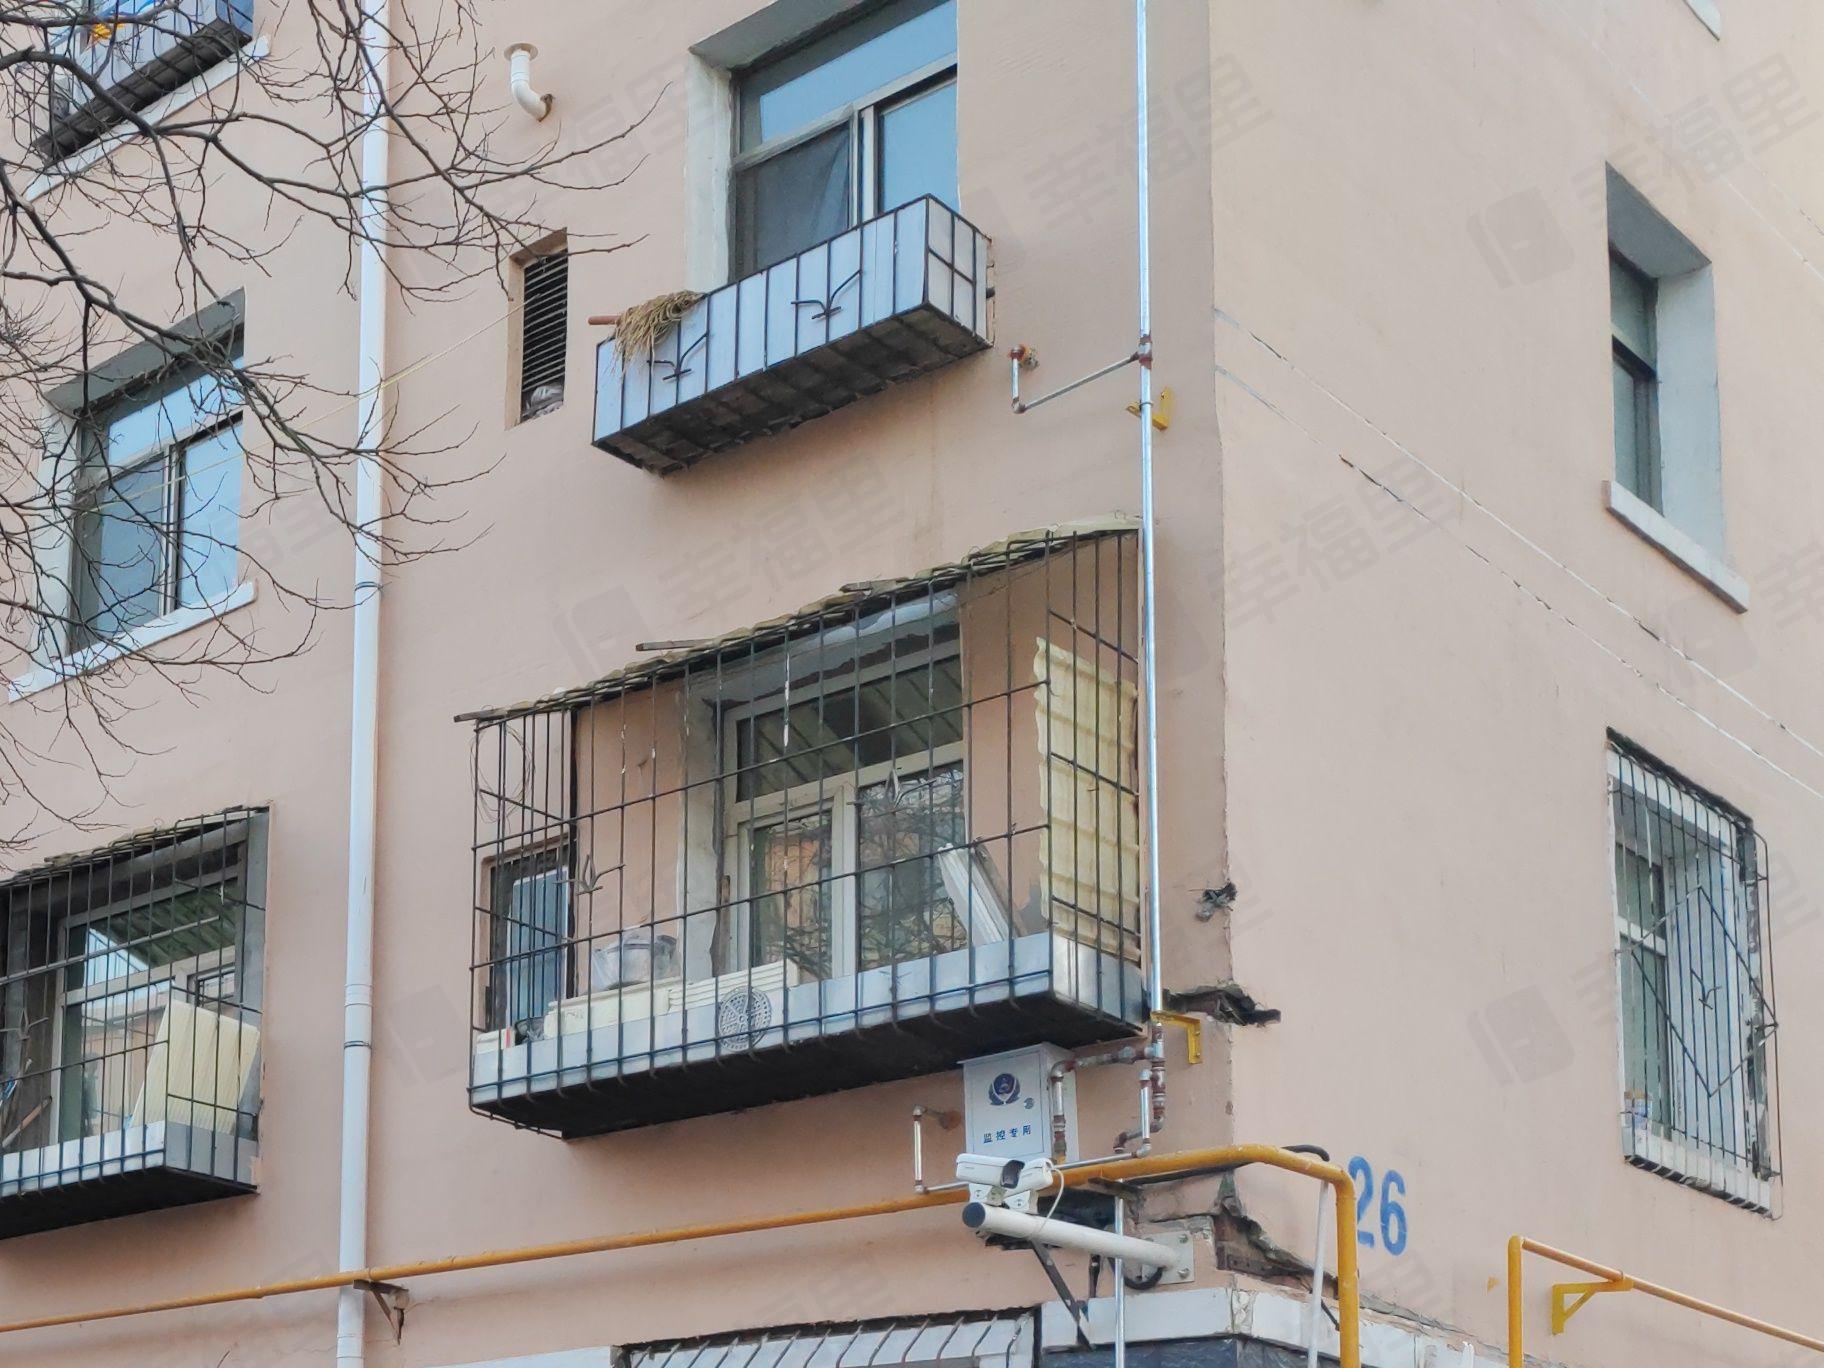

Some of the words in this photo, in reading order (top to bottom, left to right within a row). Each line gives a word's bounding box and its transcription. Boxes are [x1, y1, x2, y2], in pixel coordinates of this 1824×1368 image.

[983, 1124, 1032, 1144] 监控专用
[1348, 1155, 1408, 1256] 26
